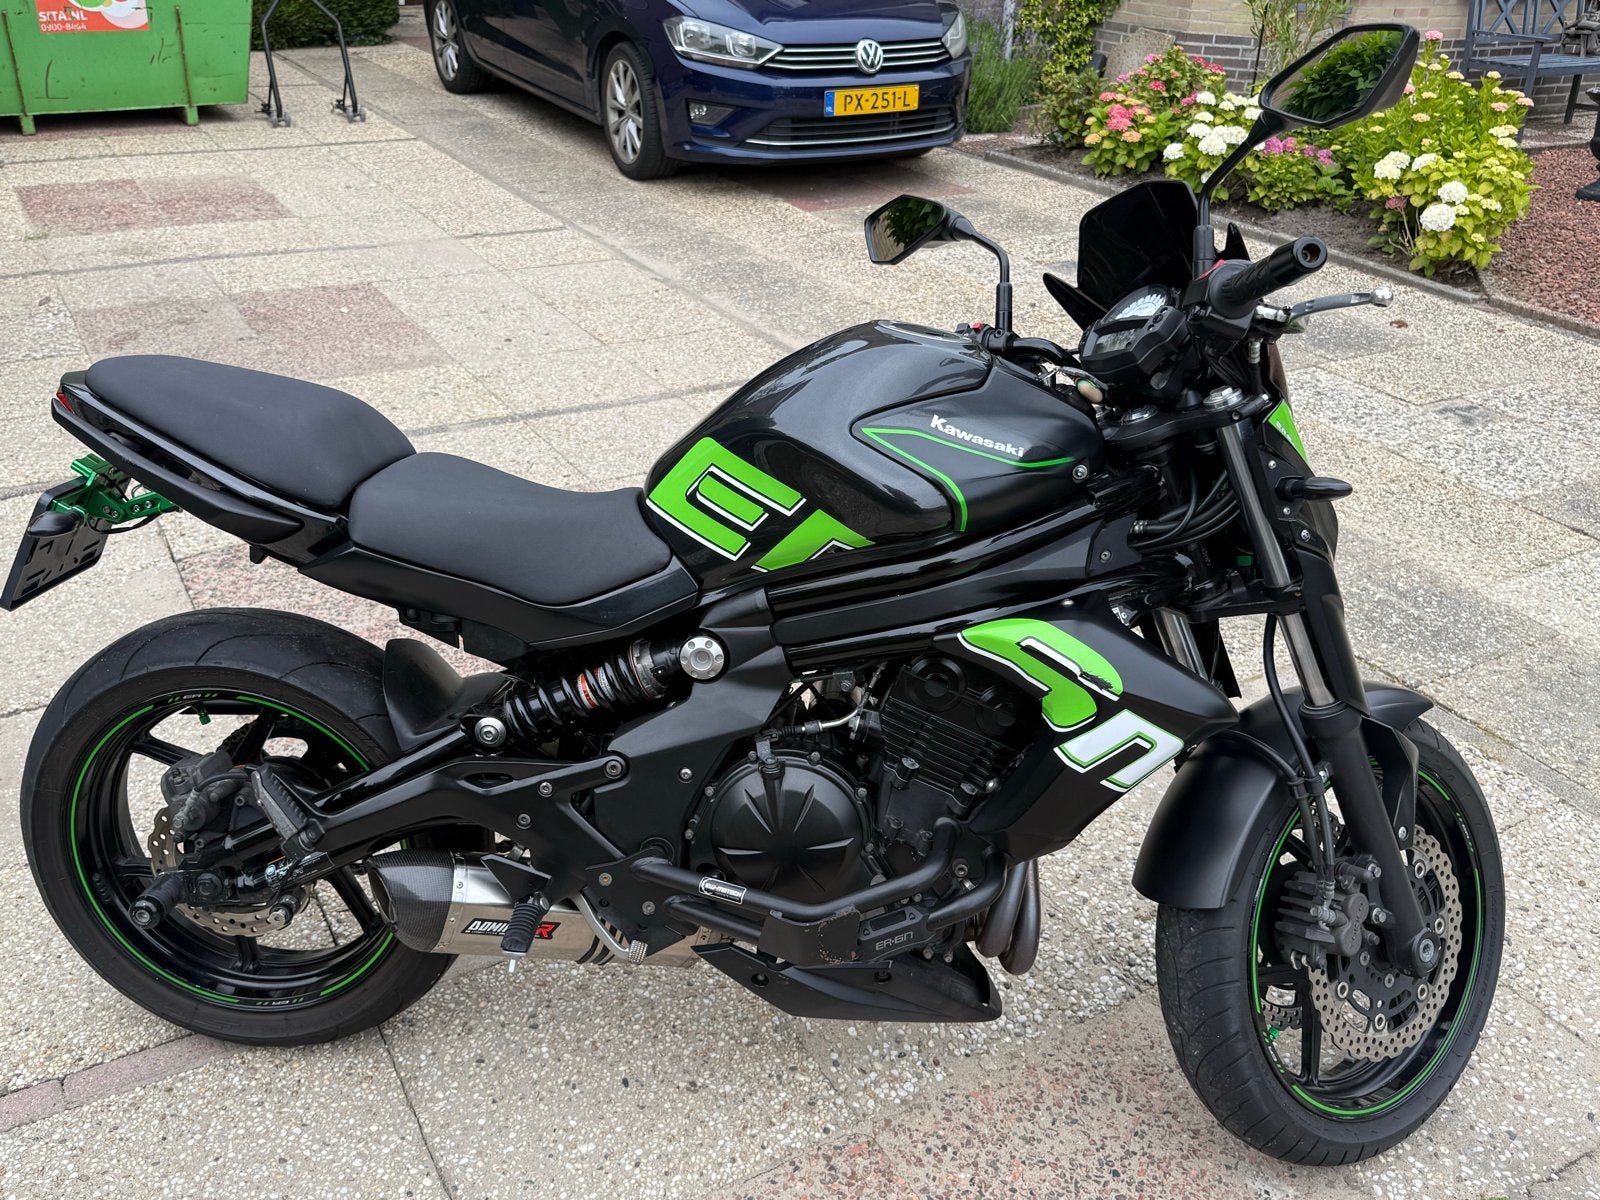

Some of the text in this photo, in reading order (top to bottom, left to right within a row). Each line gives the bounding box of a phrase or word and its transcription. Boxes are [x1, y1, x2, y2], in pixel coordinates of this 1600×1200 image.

[38, 10, 88, 21] SITA.NL
[844, 90, 911, 112] PX-251-L
[930, 414, 1025, 458] Kawasaki
